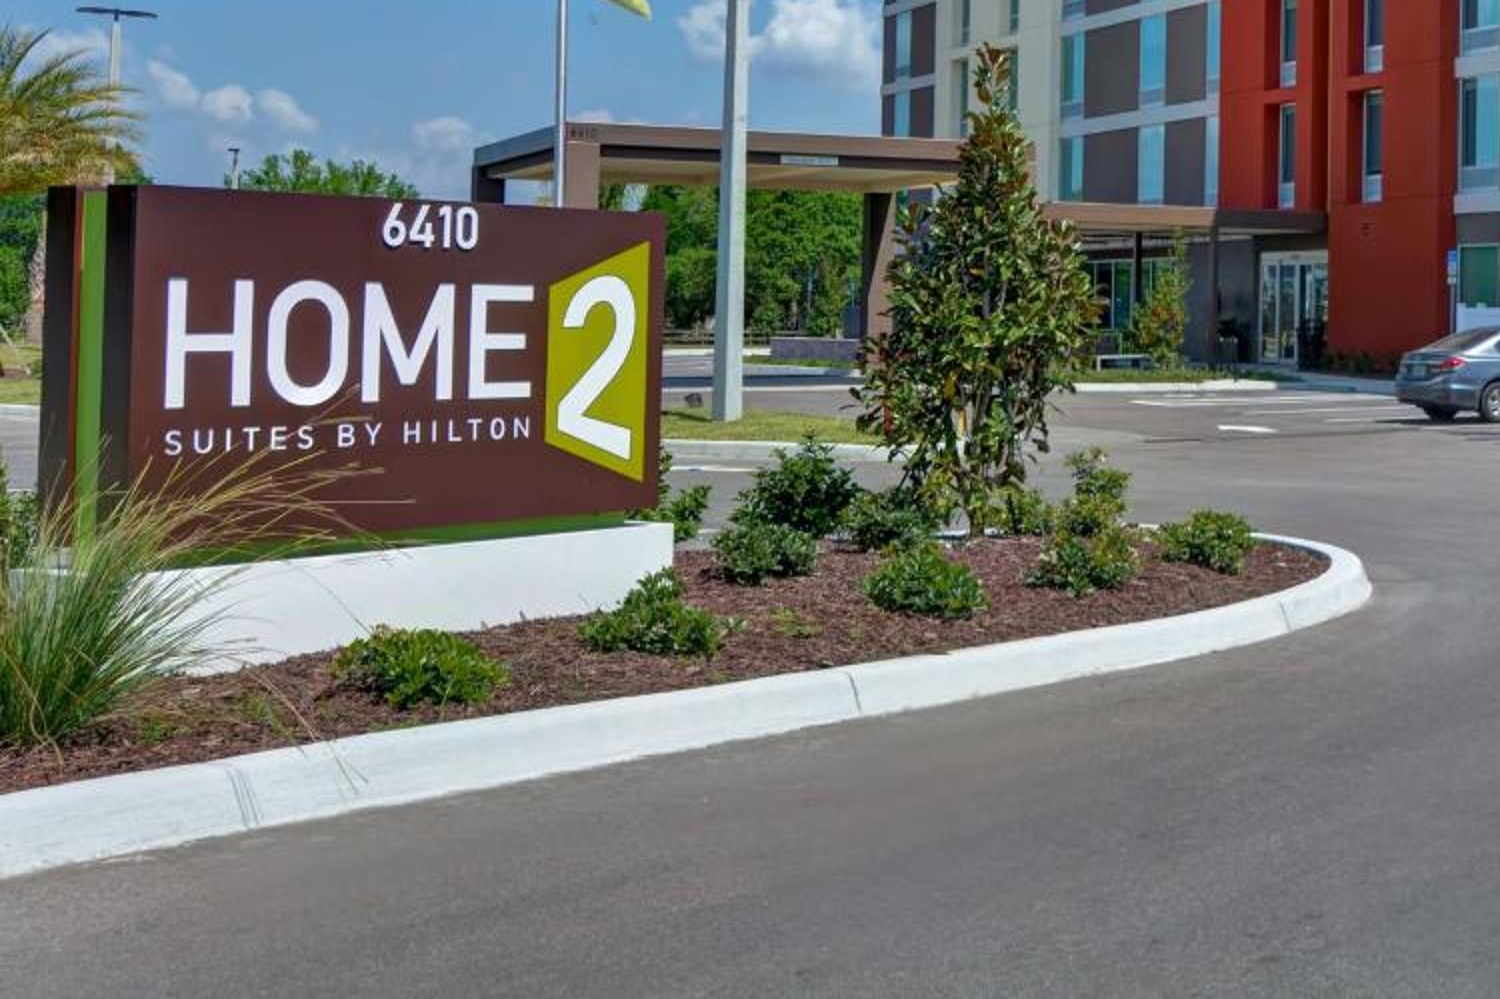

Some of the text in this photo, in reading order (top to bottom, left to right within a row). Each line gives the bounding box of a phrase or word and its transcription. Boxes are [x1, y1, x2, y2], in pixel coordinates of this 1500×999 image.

[382, 203, 479, 250] 6410
[164, 275, 636, 460] HOME 2
[164, 417, 530, 456] SUITES BY HILTON
